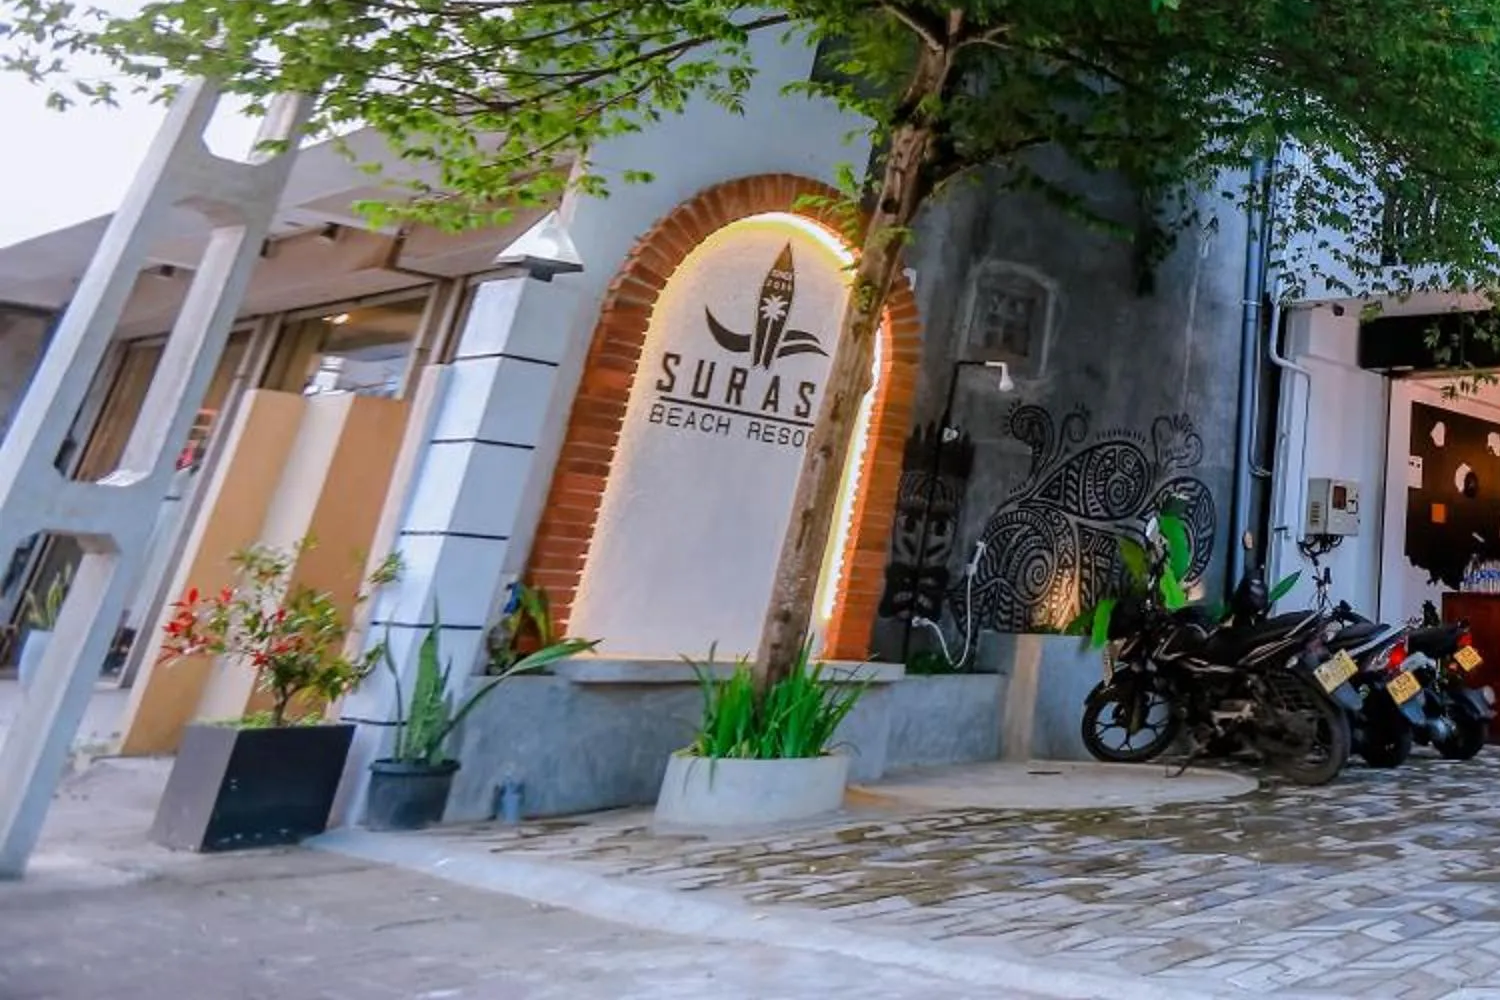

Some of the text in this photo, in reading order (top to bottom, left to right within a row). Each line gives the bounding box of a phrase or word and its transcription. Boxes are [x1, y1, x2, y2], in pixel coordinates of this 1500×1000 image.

[656, 353, 816, 418] SURAS
[648, 403, 811, 448] BEACH RESO
